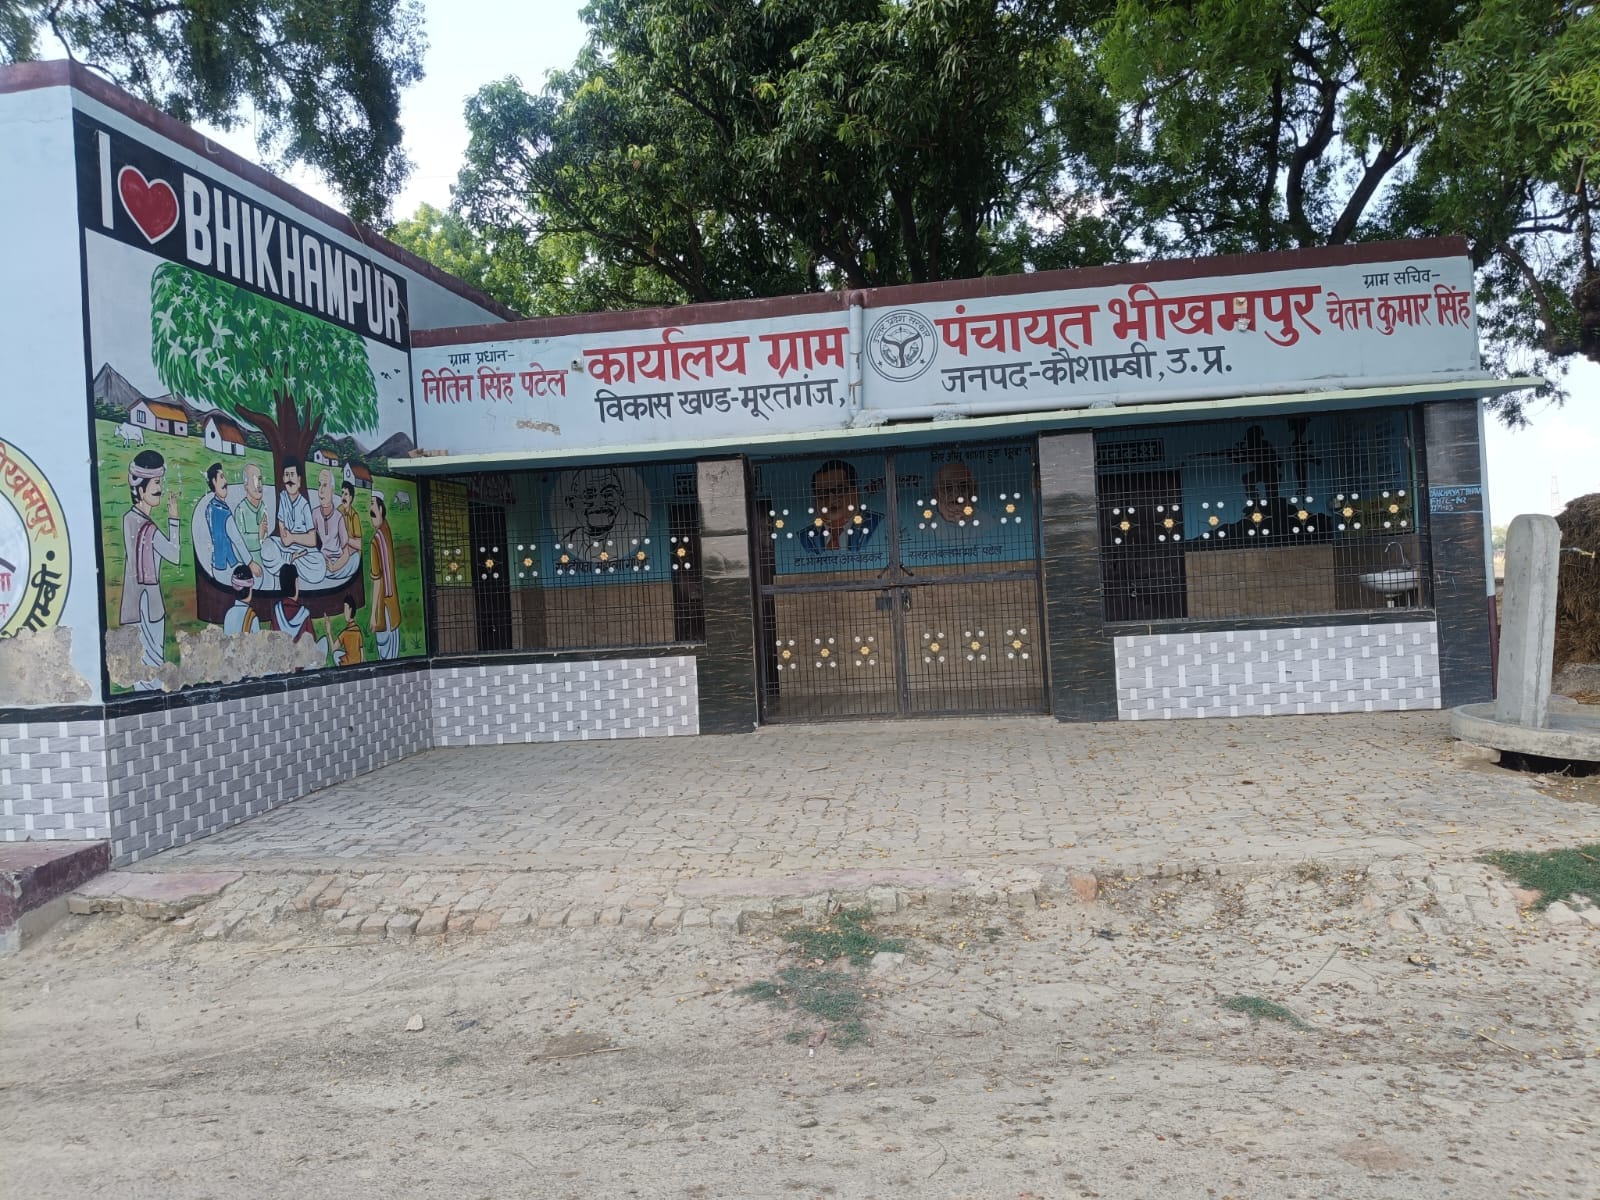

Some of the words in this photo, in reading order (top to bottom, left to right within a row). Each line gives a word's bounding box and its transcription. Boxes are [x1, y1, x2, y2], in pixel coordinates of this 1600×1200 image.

[97, 130, 115, 230] I
[183, 172, 402, 344] BHIKHAMPUR
[1362, 273, 1390, 289] ग्राम
[1326, 291, 1375, 331] चेतन
[1375, 294, 1432, 335] कुमार
[1433, 284, 1471, 329] सिंह
[583, 326, 751, 385] कार्यालय
[758, 327, 850, 379] ग्राम
[934, 304, 1101, 356] पंचायत
[1108, 283, 1322, 347] भीखमपुर
[448, 352, 471, 367] ग्राम
[477, 365, 516, 404] सिंह
[519, 362, 569, 399] पटेल
[594, 388, 674, 423] विकास
